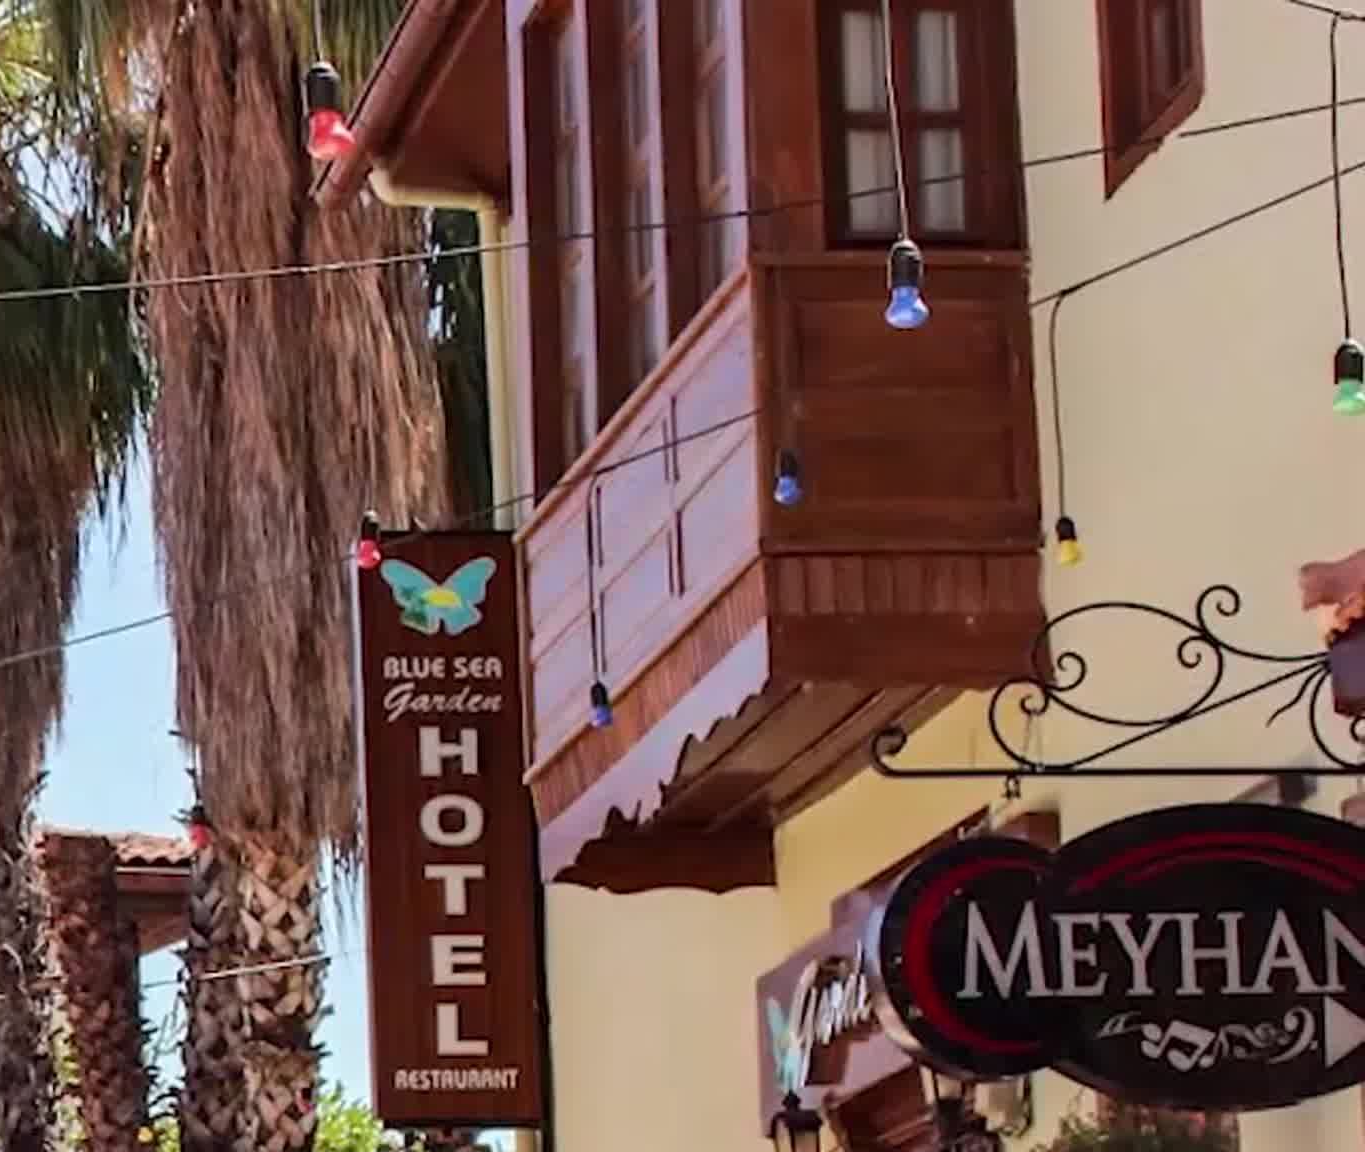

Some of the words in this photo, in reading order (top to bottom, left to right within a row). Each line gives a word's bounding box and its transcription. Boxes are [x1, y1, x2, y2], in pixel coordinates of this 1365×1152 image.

[383, 656, 445, 680] BLUE
[454, 656, 502, 679] SEA
[382, 682, 502, 723] Garden
[418, 726, 488, 1057] HOTEL
[394, 1068, 519, 1091] RESTAURANT
